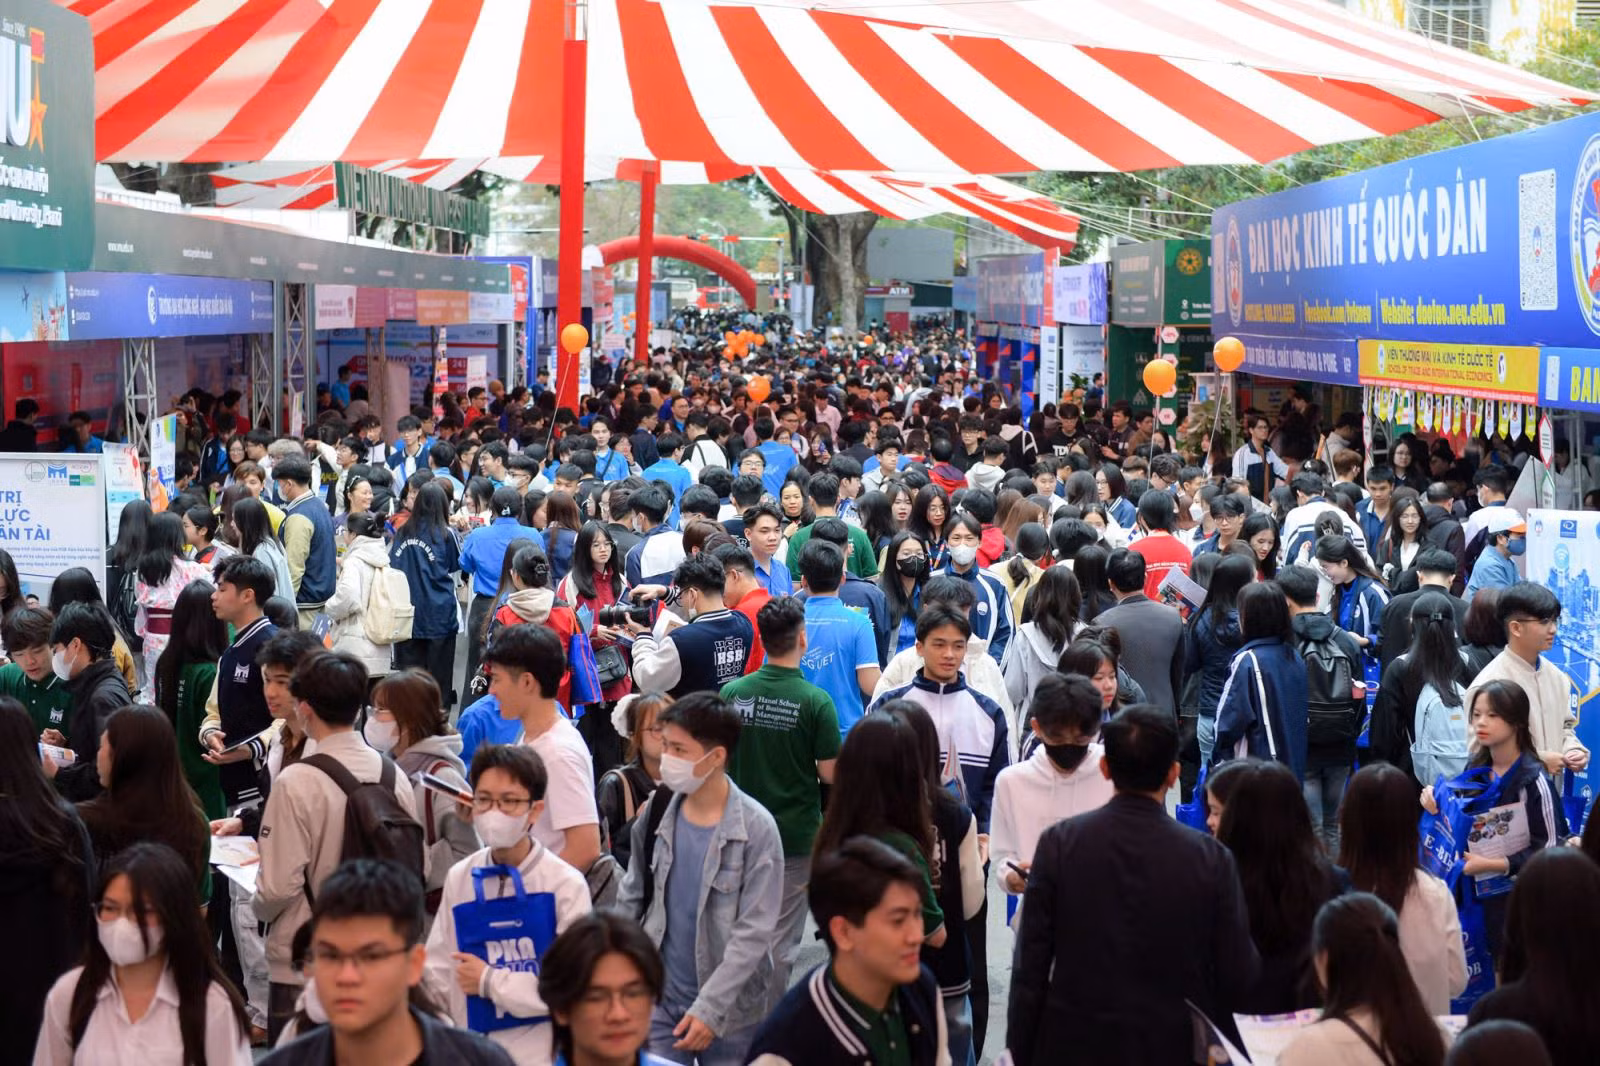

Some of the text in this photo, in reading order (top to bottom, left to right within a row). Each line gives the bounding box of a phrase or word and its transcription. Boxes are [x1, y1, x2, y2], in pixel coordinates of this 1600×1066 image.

[1248, 166, 1487, 287] ĐẠI HỌC KINH TẾ QUỐC DÂN
[888, 286, 910, 295] ATM
[1442, 352, 1457, 365] KINH
[1458, 346, 1465, 365] TẾ
[1485, 349, 1494, 367] TẾ
[0, 508, 31, 526] ỰC
[24, 524, 50, 541] TÀI
[717, 649, 743, 665] HSB
[758, 695, 801, 710] Hanoi School
[765, 704, 793, 716] Business
[792, 708, 800, 717] &
[756, 711, 798, 723] Management
[485, 936, 537, 966] PKA
